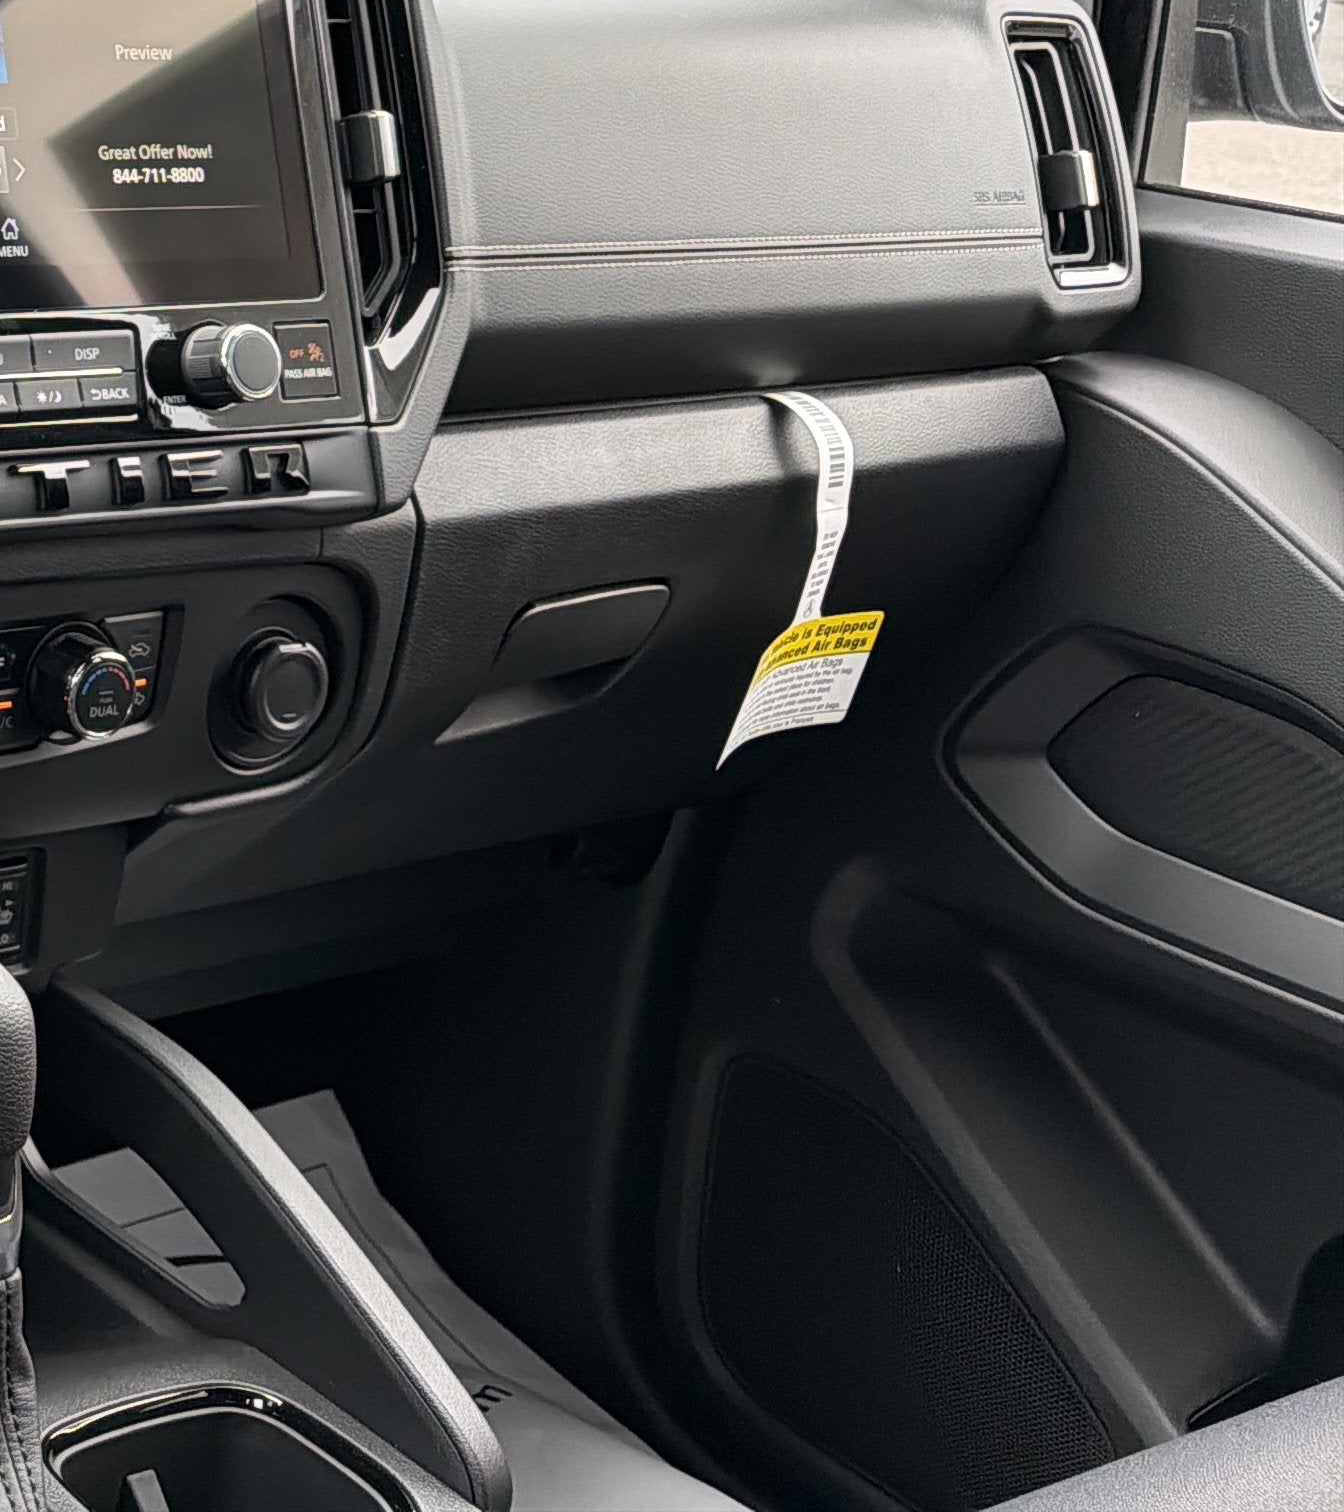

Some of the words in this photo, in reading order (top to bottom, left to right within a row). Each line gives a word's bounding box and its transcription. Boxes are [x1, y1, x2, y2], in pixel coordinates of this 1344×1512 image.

[114, 44, 173, 62] Preview
[97, 144, 136, 161] Great
[138, 143, 175, 160] Offer
[177, 143, 213, 160] Now!
[112, 168, 204, 184] 844-711-8800
[74, 347, 100, 361] DISP
[101, 388, 130, 401] BACK
[815, 618, 878, 637] Equipped
[812, 638, 832, 652] Air
[834, 637, 868, 651] Bags
[89, 705, 119, 719] DUAL
